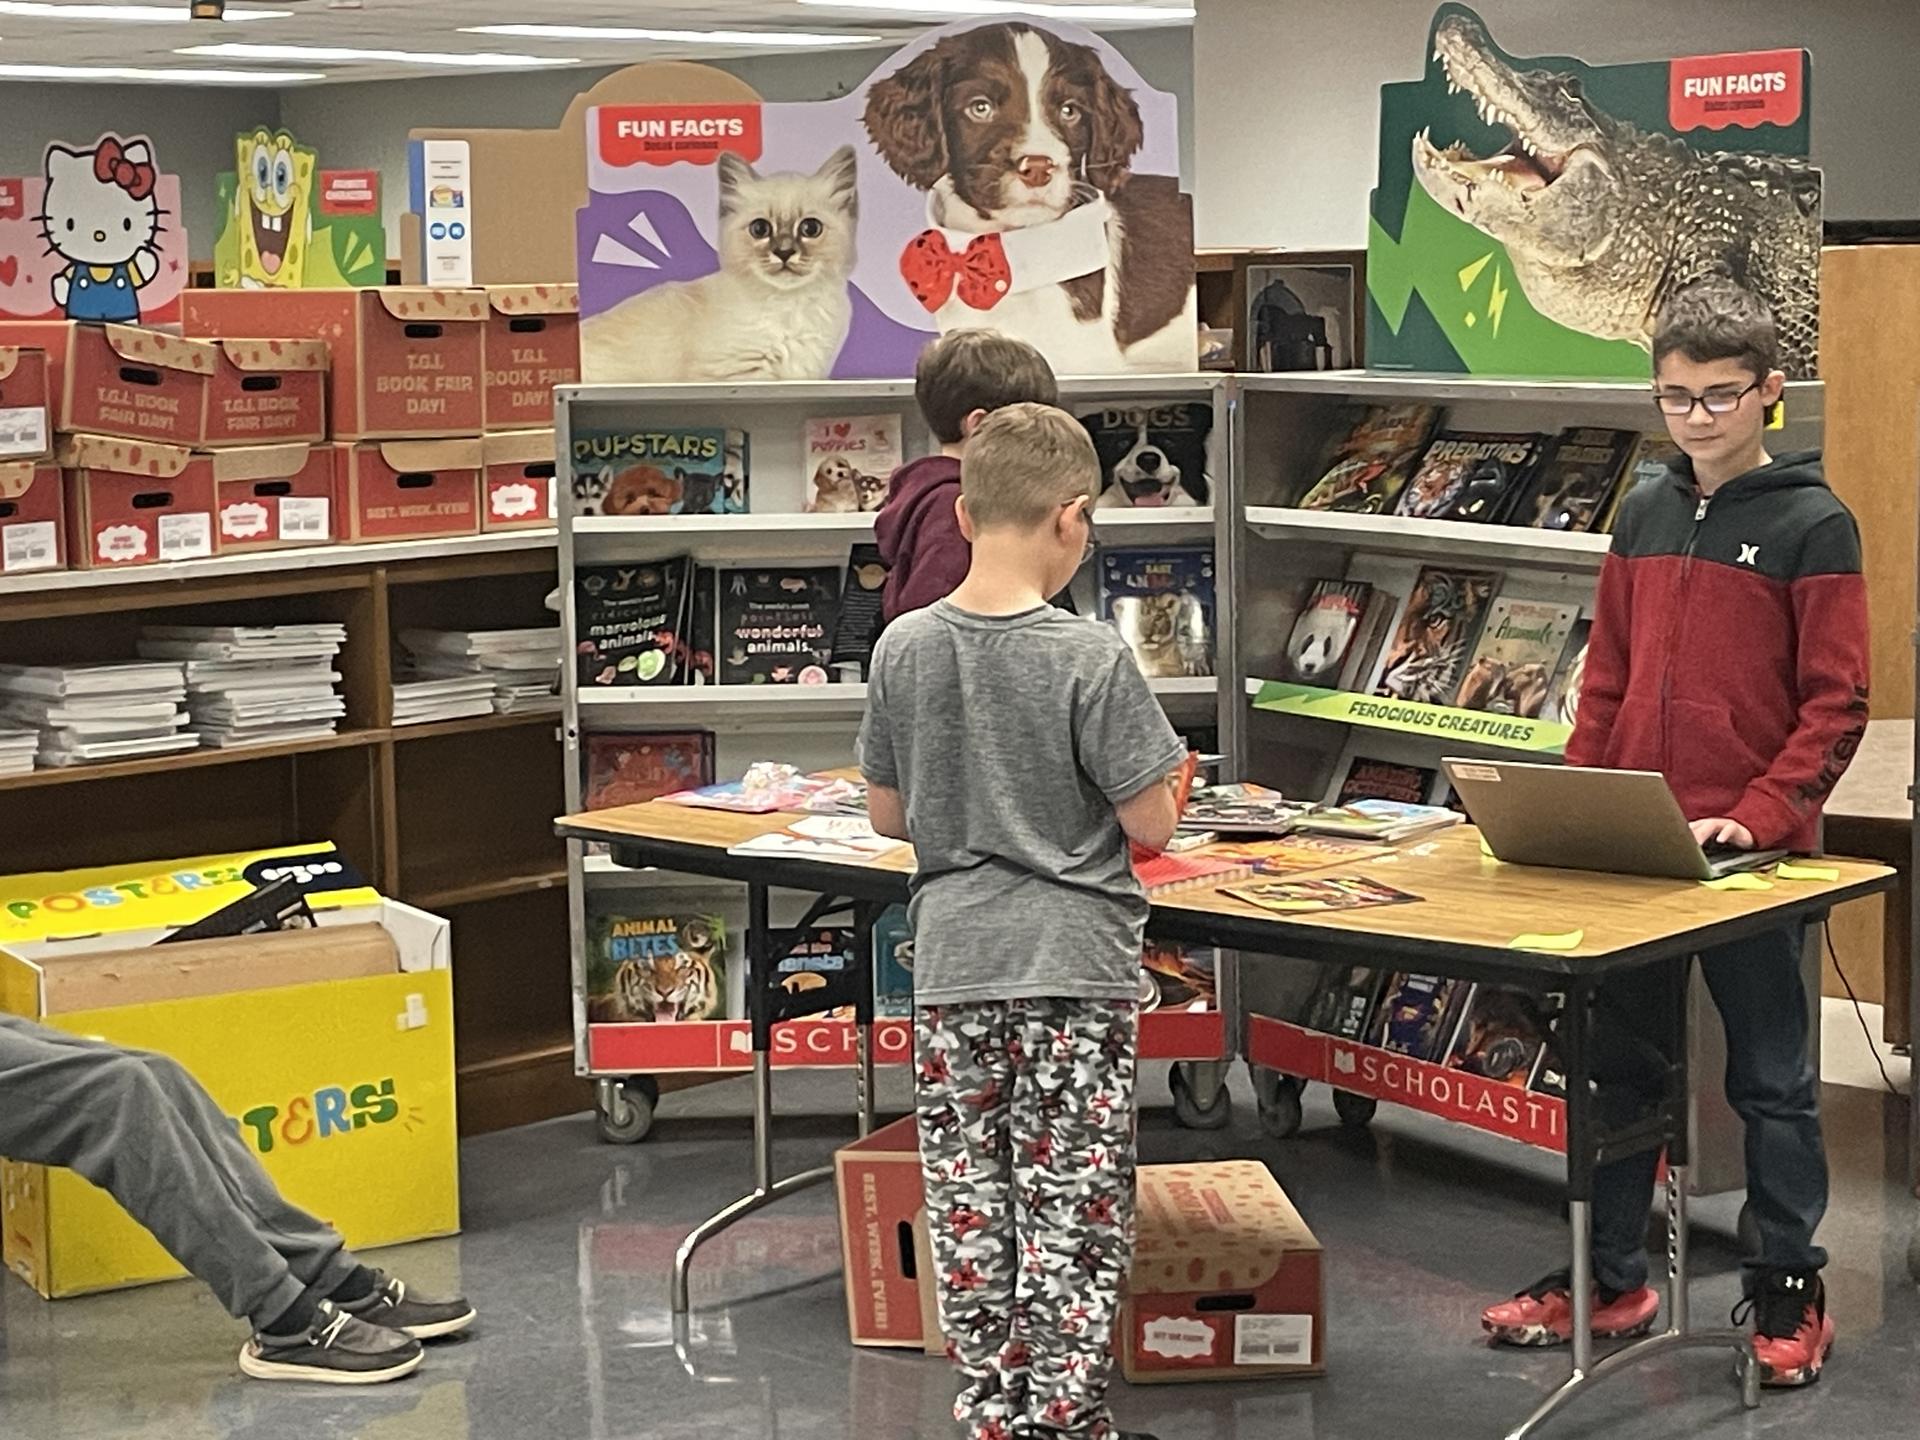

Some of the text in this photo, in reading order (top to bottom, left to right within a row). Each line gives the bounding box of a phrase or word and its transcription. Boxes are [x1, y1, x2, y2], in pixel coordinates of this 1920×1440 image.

[1684, 71, 1787, 98] FUN FACTS
[617, 118, 744, 138] FUN FACTS
[376, 375, 475, 392] BOOK FAIR
[406, 398, 447, 414] DAY!
[1103, 406, 1191, 429] DOGS
[573, 433, 718, 460] PUPSTARS
[1422, 439, 1533, 464] PREDATORS
[1349, 701, 1534, 741] FEROCIOUS CREATURES
[7, 866, 244, 919] POSTERS
[612, 918, 677, 938] ANIMAL
[611, 934, 680, 961] BITES
[1362, 1056, 1556, 1136] SCHOLASTI
[240, 1077, 399, 1153] TERS
